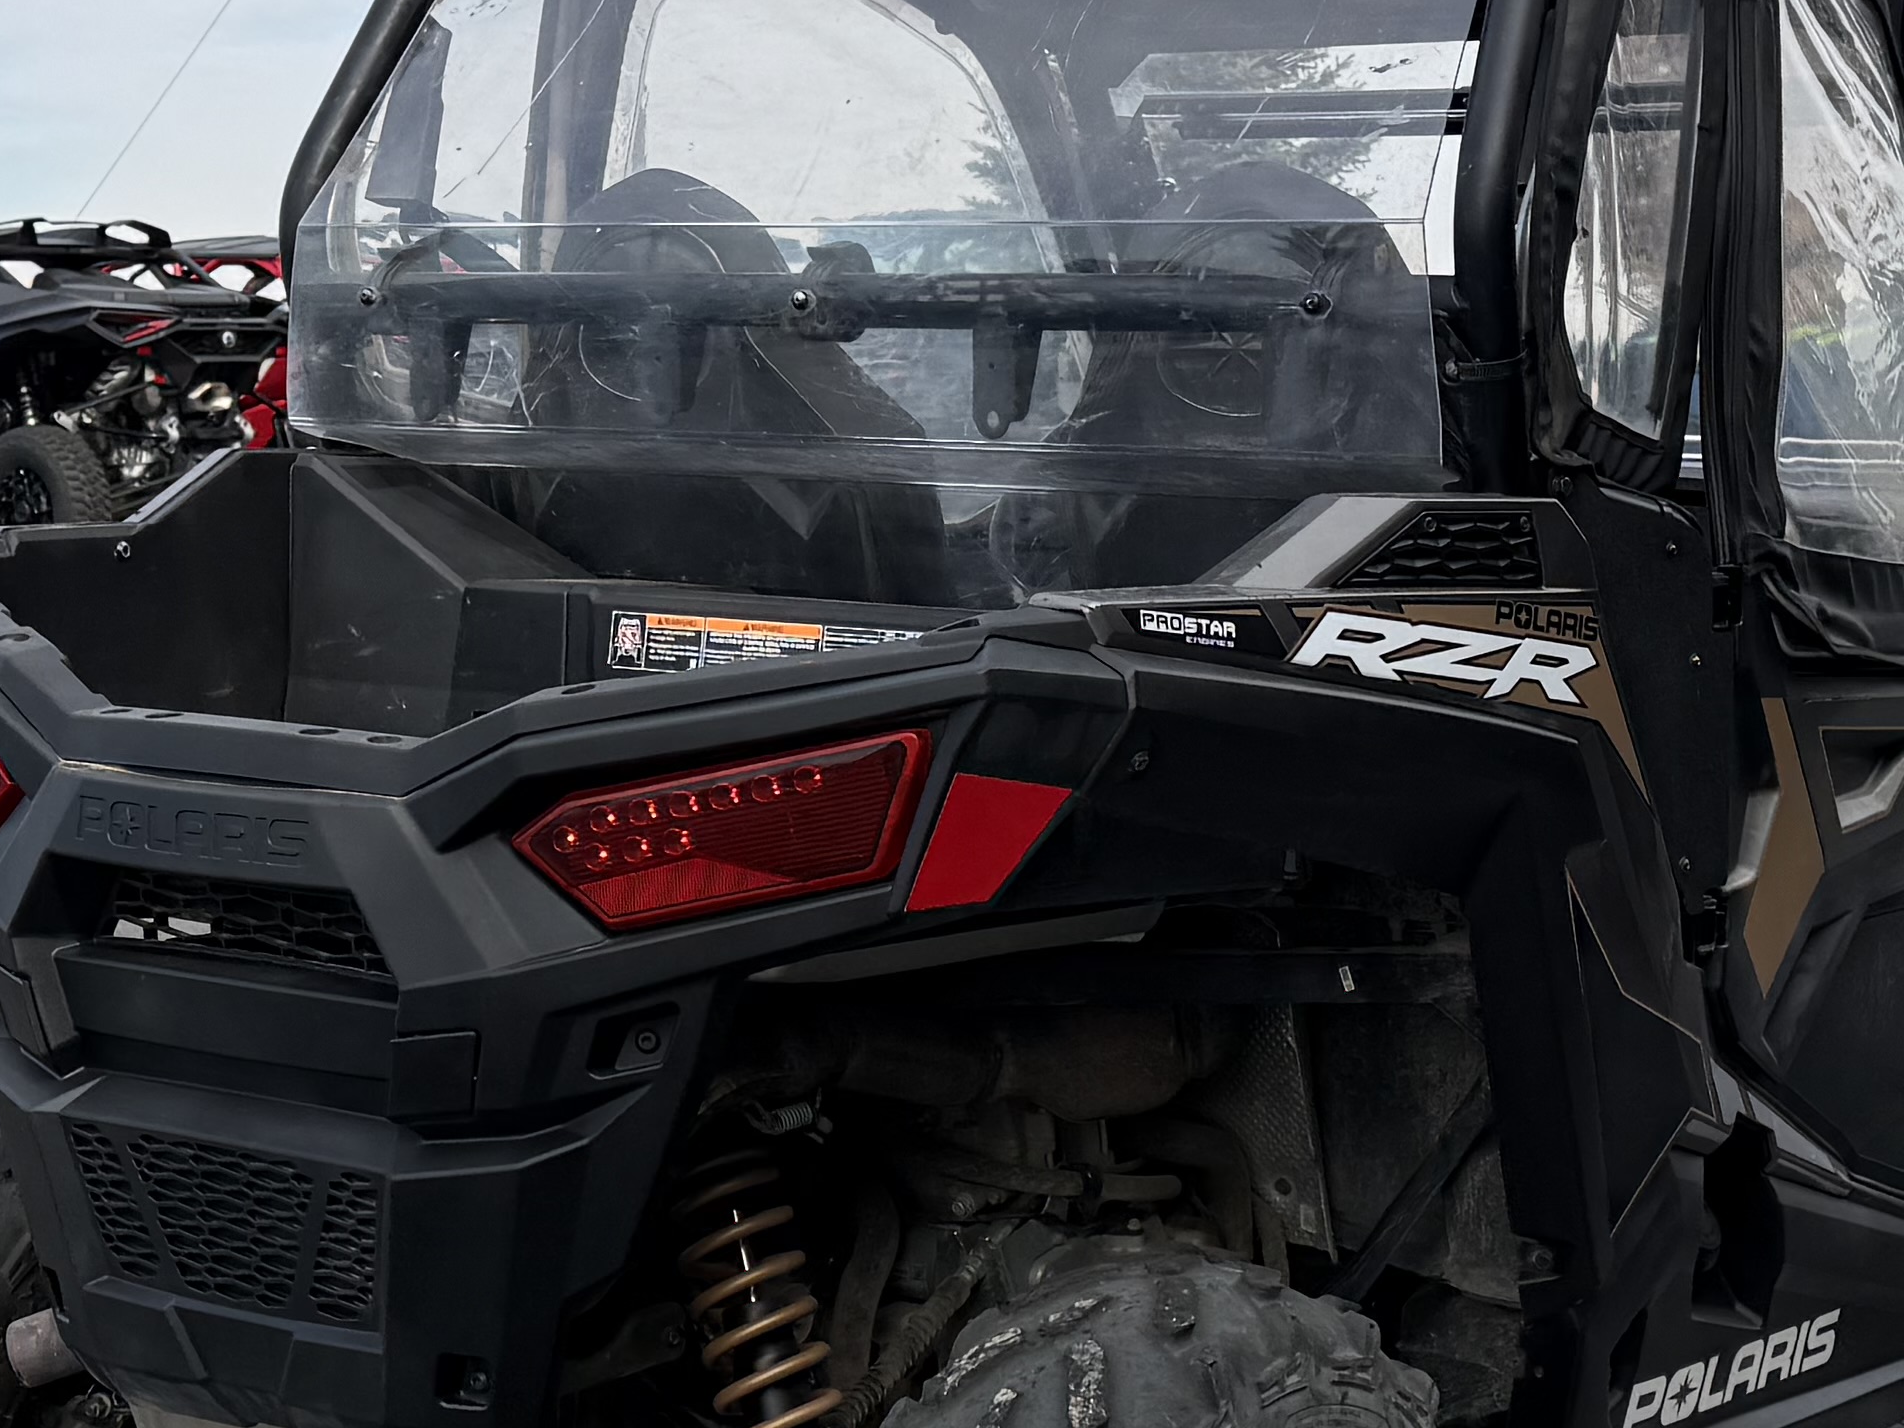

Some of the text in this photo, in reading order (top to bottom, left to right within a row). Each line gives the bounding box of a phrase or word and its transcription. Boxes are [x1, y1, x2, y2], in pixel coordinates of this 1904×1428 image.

[1139, 609, 1237, 639] PROSTAR
[1495, 600, 1600, 642] POLARIS
[1288, 610, 1600, 706] RZR
[76, 794, 310, 869] POLARIS
